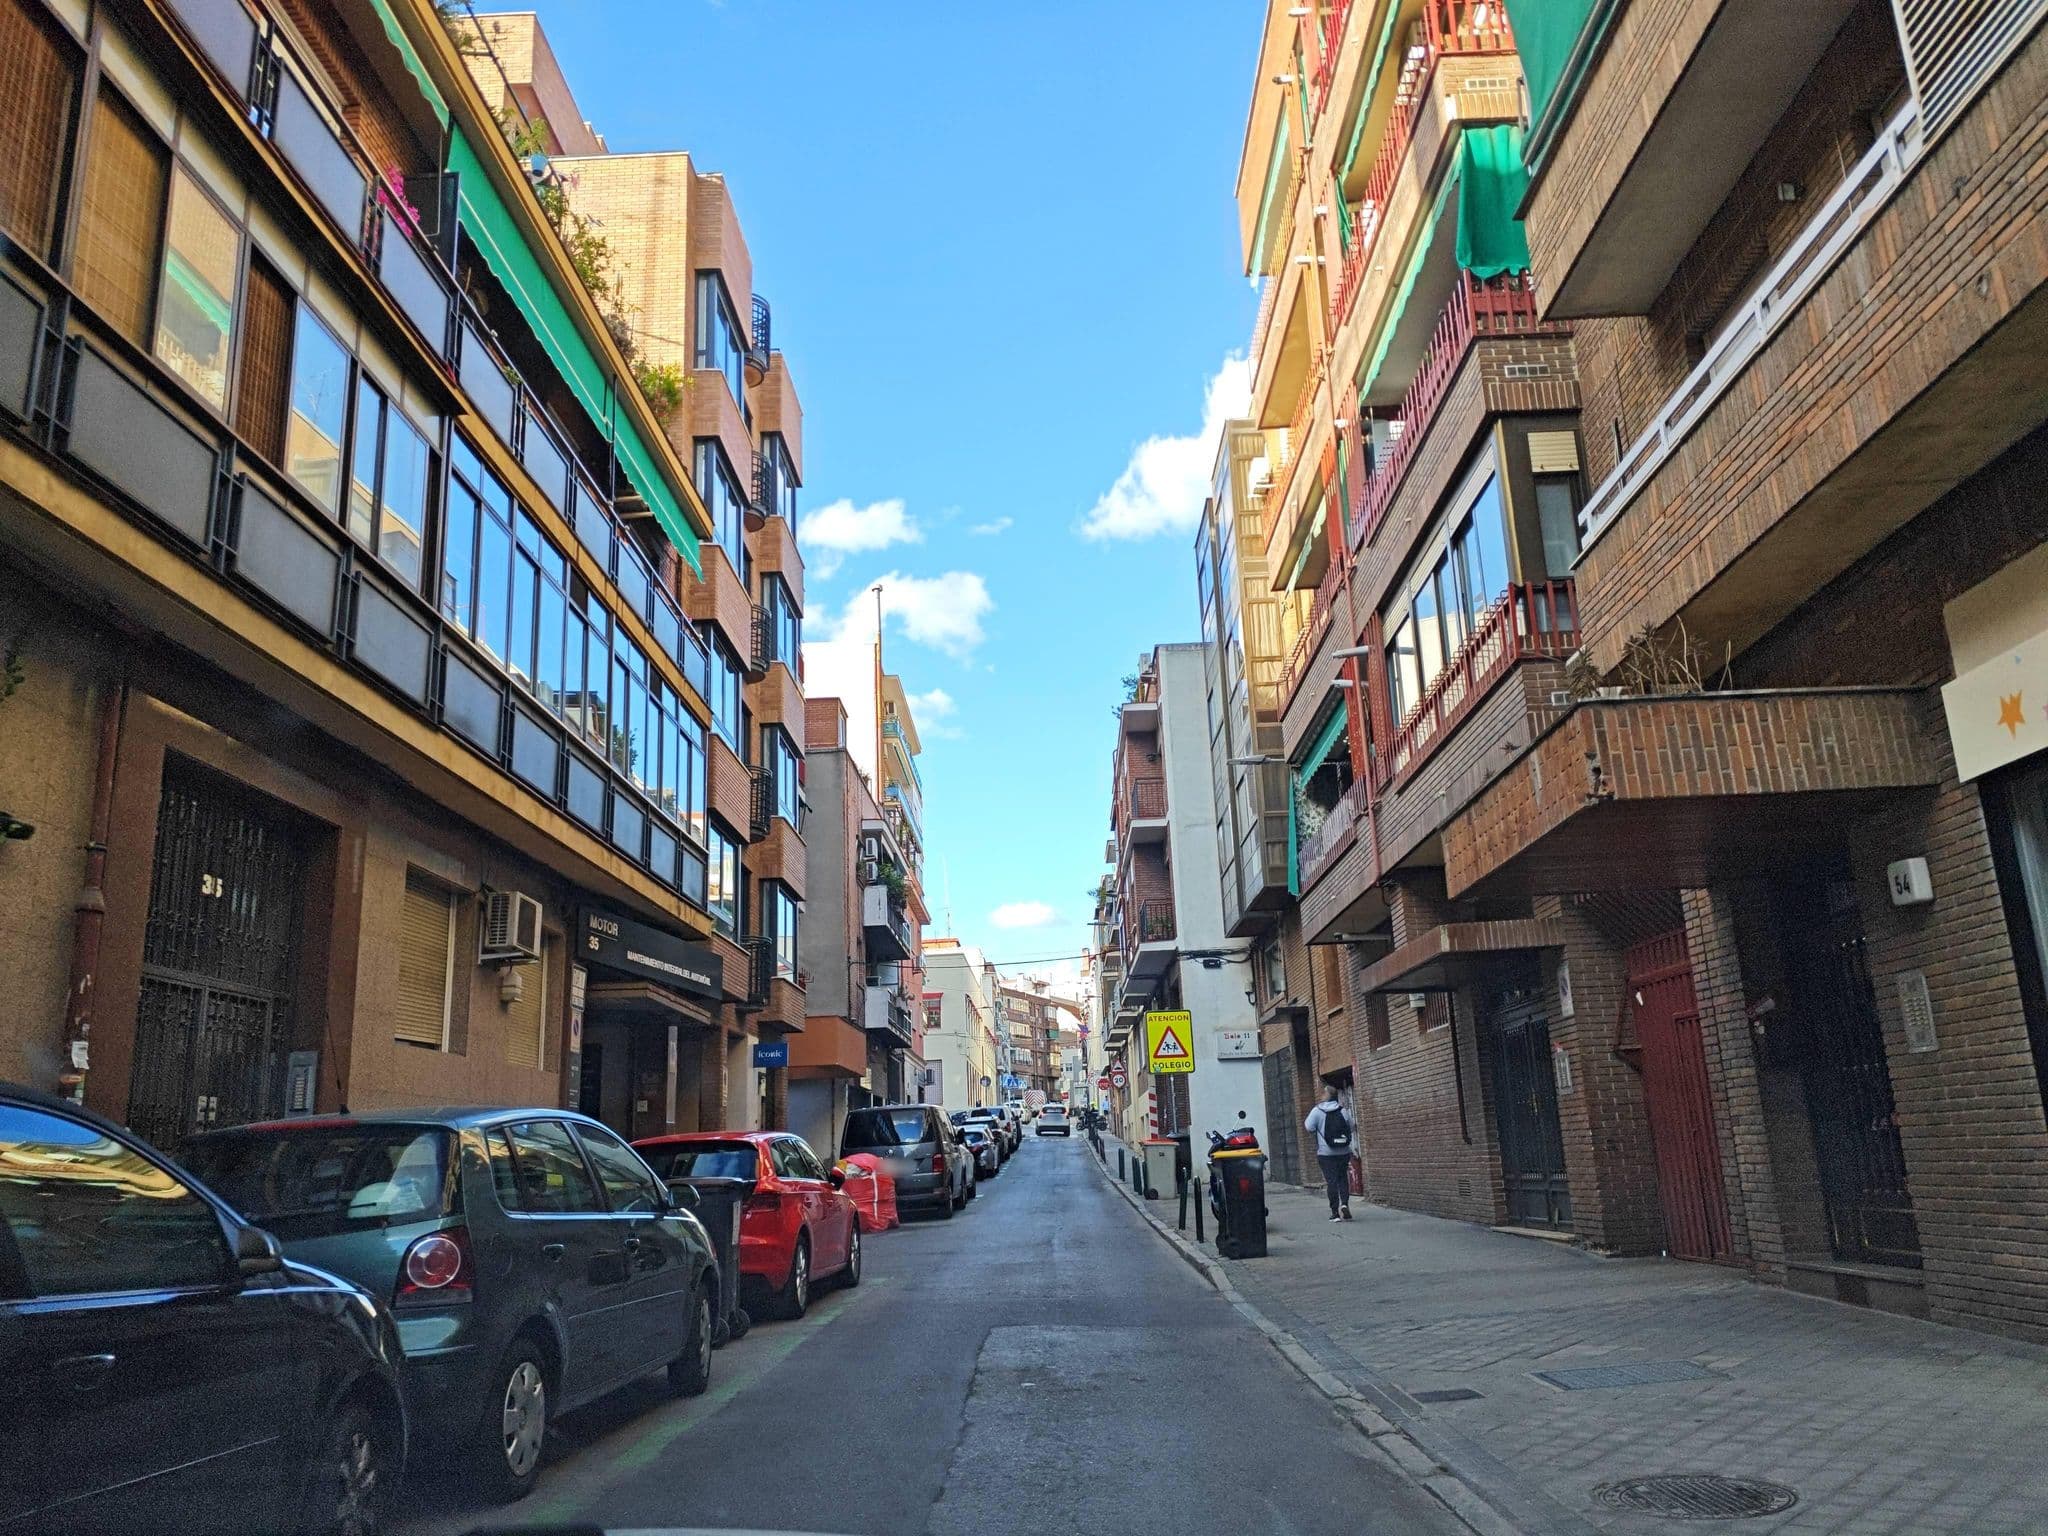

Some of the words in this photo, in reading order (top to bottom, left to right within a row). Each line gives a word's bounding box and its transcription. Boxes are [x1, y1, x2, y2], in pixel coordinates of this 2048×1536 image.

[202, 873, 223, 898] 35
[1894, 874, 1911, 895] 54
[589, 915, 618, 936] MOTOR
[588, 936, 599, 951] 35
[1148, 1014, 1189, 1022] ATENCION
[1152, 1061, 1191, 1069] COLEGIO
